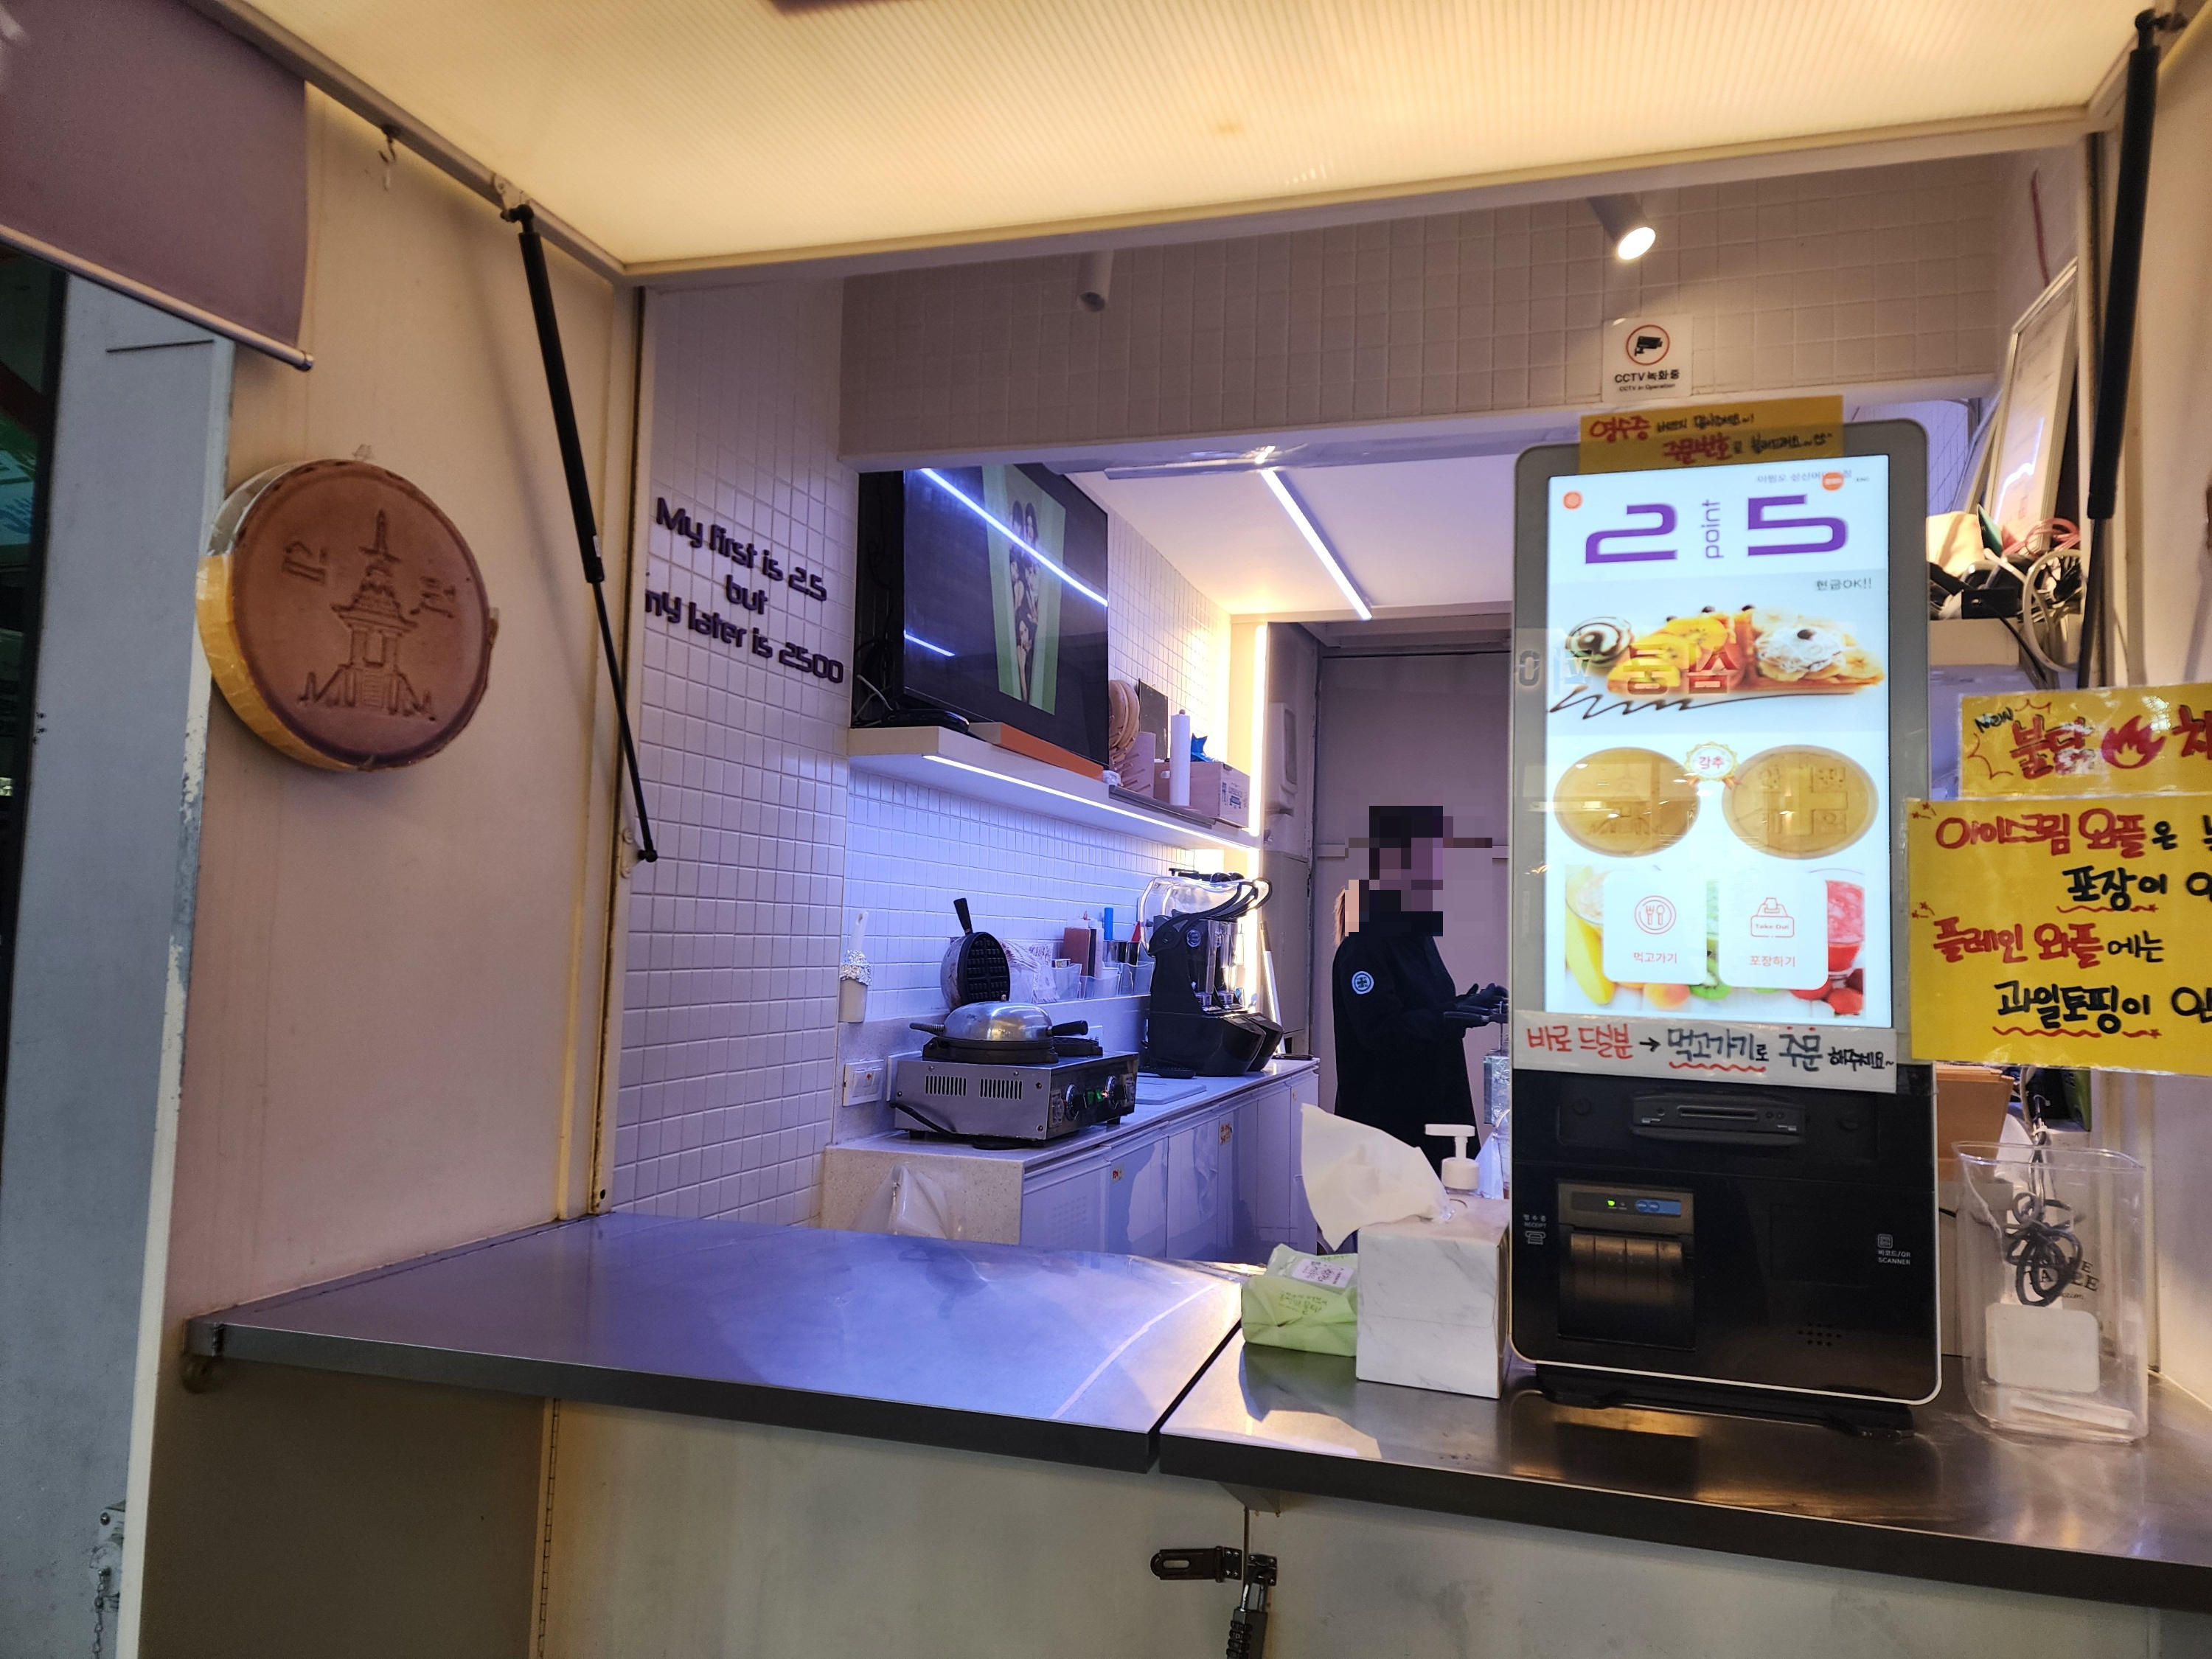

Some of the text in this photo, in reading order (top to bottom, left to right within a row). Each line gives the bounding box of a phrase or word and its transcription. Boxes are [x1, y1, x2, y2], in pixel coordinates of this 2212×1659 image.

[1590, 415, 1651, 444] 영수증
[656, 497, 703, 549] My
[709, 524, 758, 568] first
[762, 549, 783, 581] is
[1585, 494, 1849, 565] 2 point 5
[726, 574, 768, 615] but
[1815, 577, 1871, 591] 현금OK!!
[688, 602, 747, 647] later
[752, 627, 773, 658] is
[779, 641, 844, 684] 2500
[1935, 813, 2071, 856] 아이스크림
[2062, 865, 2168, 911] 포장이
[1633, 952, 1677, 964] 먹고가기
[1750, 955, 1796, 967] 포장하기
[1933, 916, 2028, 964] 플레인
[1994, 979, 2151, 1034] 과일토핑이
[1578, 1023, 1633, 1059] 드실분
[1878, 1257, 1911, 1265] SCANNER
